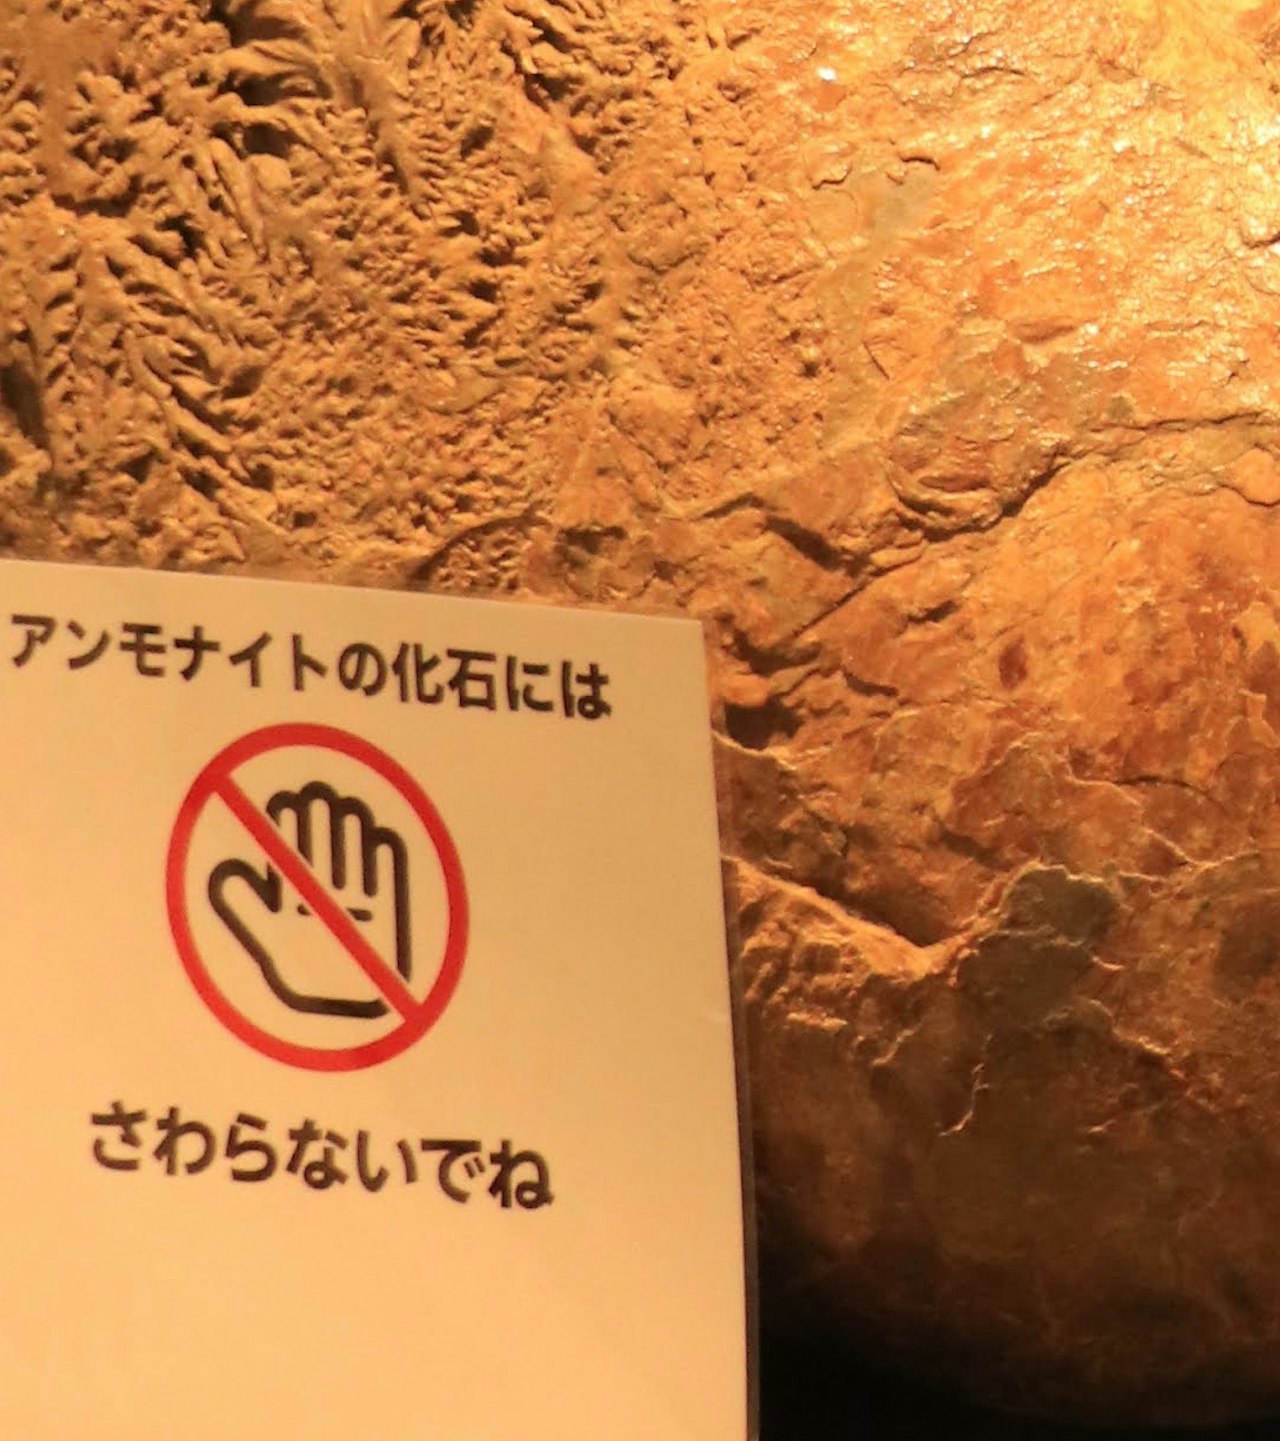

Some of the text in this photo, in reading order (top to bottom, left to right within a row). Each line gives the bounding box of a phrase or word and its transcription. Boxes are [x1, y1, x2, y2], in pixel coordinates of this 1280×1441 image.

[10, 613, 613, 722] アンモナイトの化石には
[90, 1101, 555, 1211] さわらないでね
